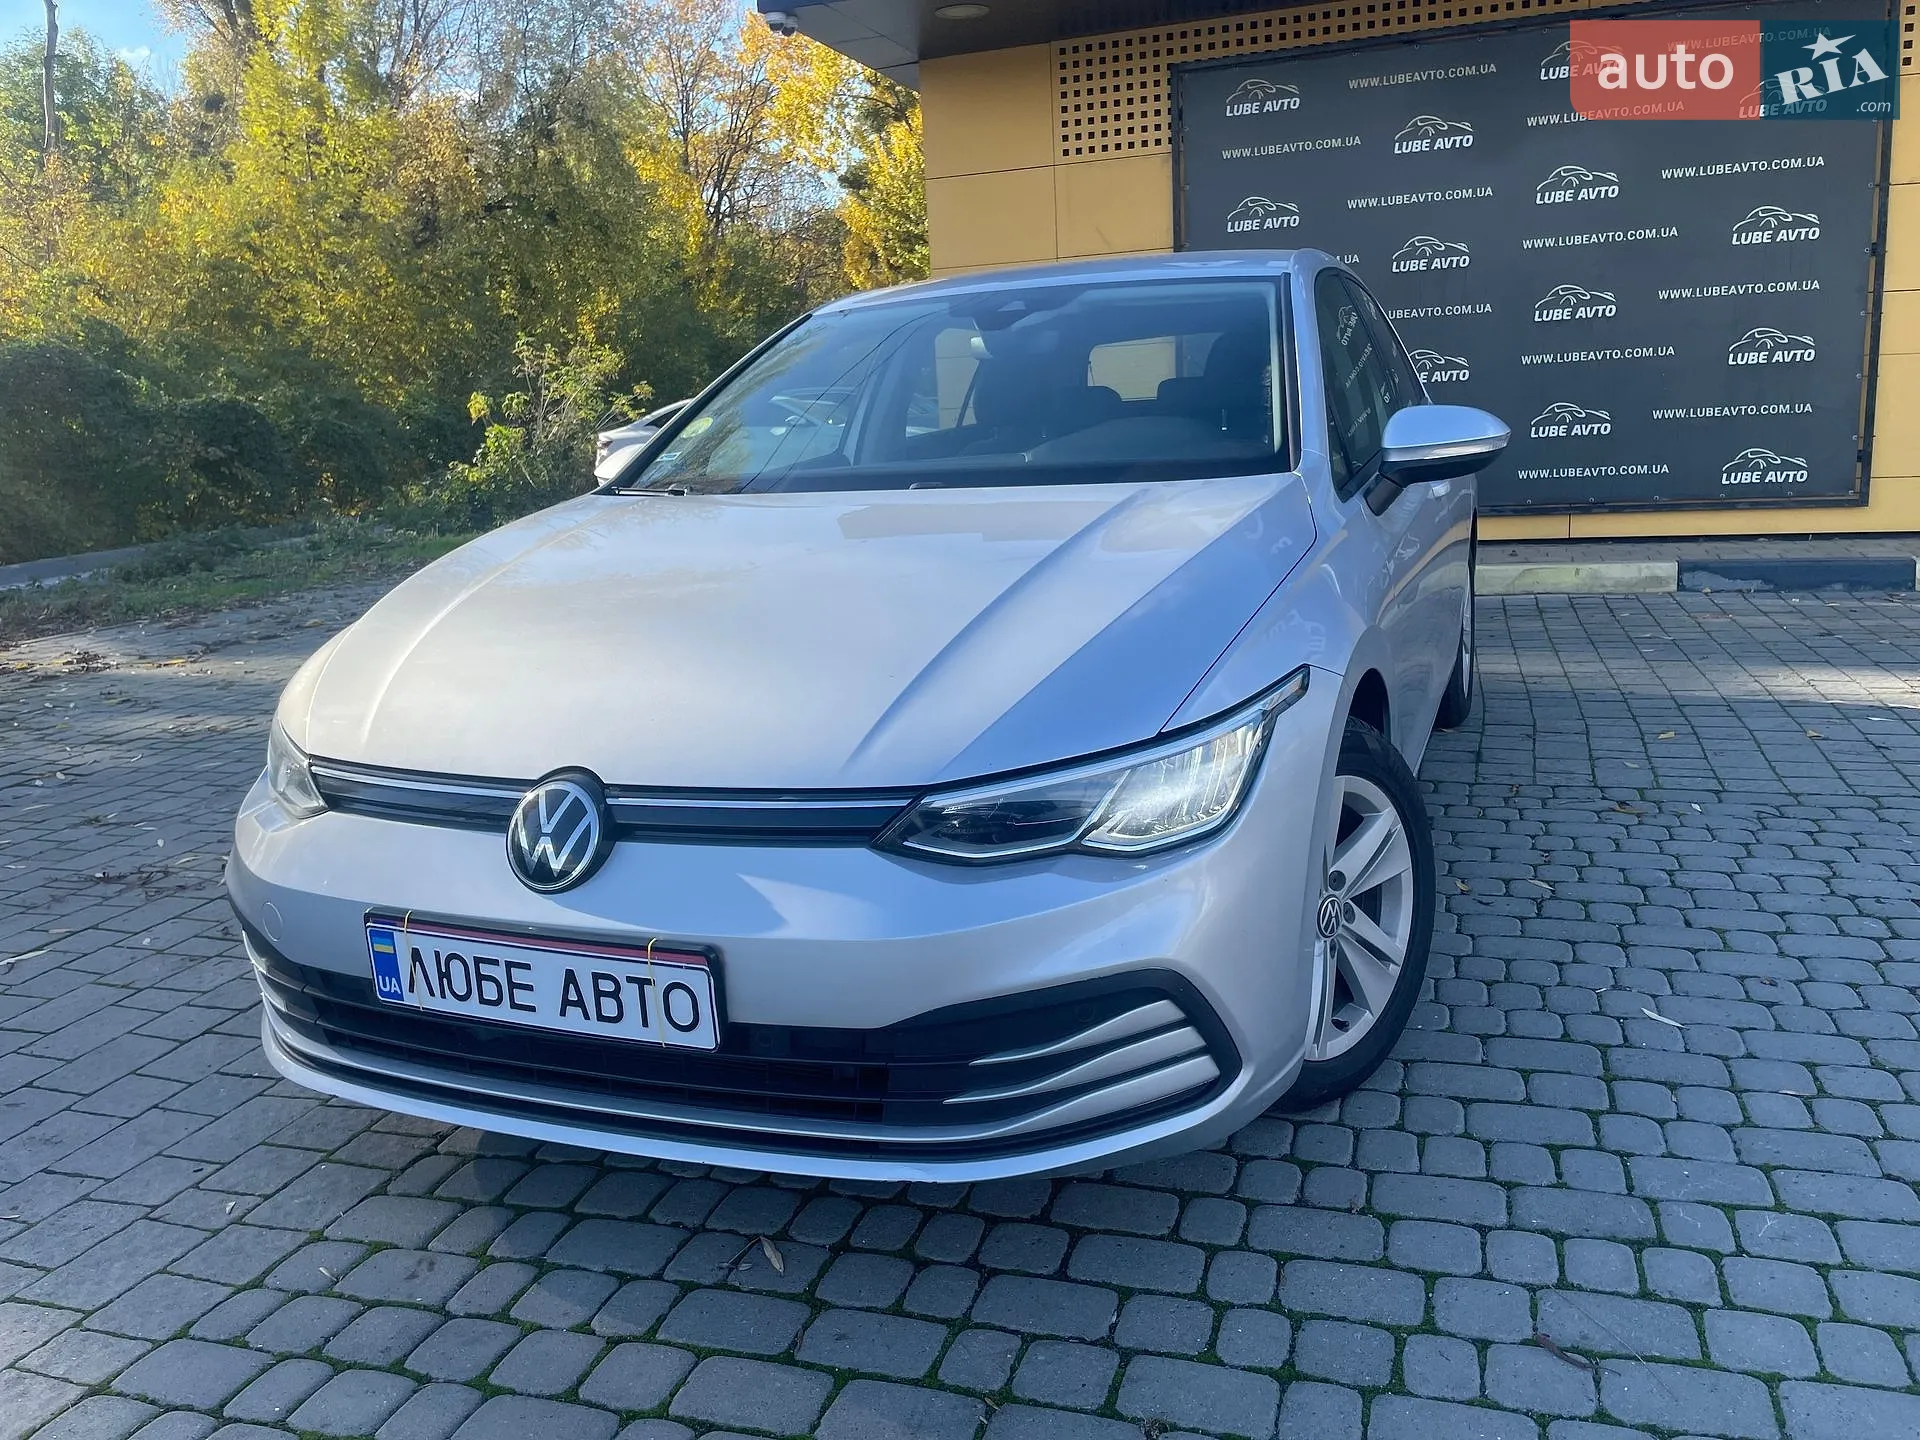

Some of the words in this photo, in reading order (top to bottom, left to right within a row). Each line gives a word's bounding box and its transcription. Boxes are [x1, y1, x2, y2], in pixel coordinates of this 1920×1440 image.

[1349, 64, 1496, 89] WWW.LUBEAVTO.COM.UA
[1540, 65, 1579, 80] LUBE
[1227, 101, 1260, 116] LUBE
[1263, 98, 1299, 112] AVTO
[1527, 101, 1685, 127] WWW.LUBEAVTO.COM.UA
[1222, 136, 1361, 159] WWW.LUBEAVTO.COM.UA
[1394, 139, 1430, 153] LUBE
[1434, 135, 1473, 149] AVTO
[1662, 157, 1824, 178] WWW.LUBEAVTO.COM.UA
[1348, 187, 1493, 208] WWW.LUBEAVTO.COM.UA
[1536, 187, 1575, 204] LUBE
[1577, 183, 1618, 200] AVTO
[1227, 218, 1260, 232] LUBE
[1264, 216, 1299, 229] AVTO
[1523, 227, 1678, 249] WWW.LUBEAVTO.COM.UA
[1732, 229, 1773, 244] LUBE
[1776, 228, 1819, 241] AVTO
[1393, 258, 1428, 272] LUBE
[1431, 256, 1469, 269] AVTO
[1659, 280, 1819, 299] WWW.LUBEAVTO.COM.UA
[1388, 303, 1492, 319] UBEAVTO.COM.UA
[1535, 307, 1572, 321] LUBE
[1575, 305, 1616, 318] AVTO
[1522, 346, 1674, 364] WWW.LUBEAVTO.COM.UA
[1729, 351, 1768, 364] LUBE
[1772, 349, 1815, 362] AVTO
[1431, 370, 1470, 382] AVTO
[1653, 404, 1812, 419] WWW.LUBEAVTO.COM.UA
[1531, 424, 1568, 437] LUBE
[1571, 423, 1611, 435] AVTO
[1518, 464, 1669, 479] WWW.LUBEAVTO.COM.UA
[1722, 471, 1762, 484] LUBE
[1765, 470, 1807, 482] AVTO
[379, 974, 401, 994] UA
[408, 946, 537, 1013] ЛЮБЕ
[559, 968, 701, 1033] АВТО
